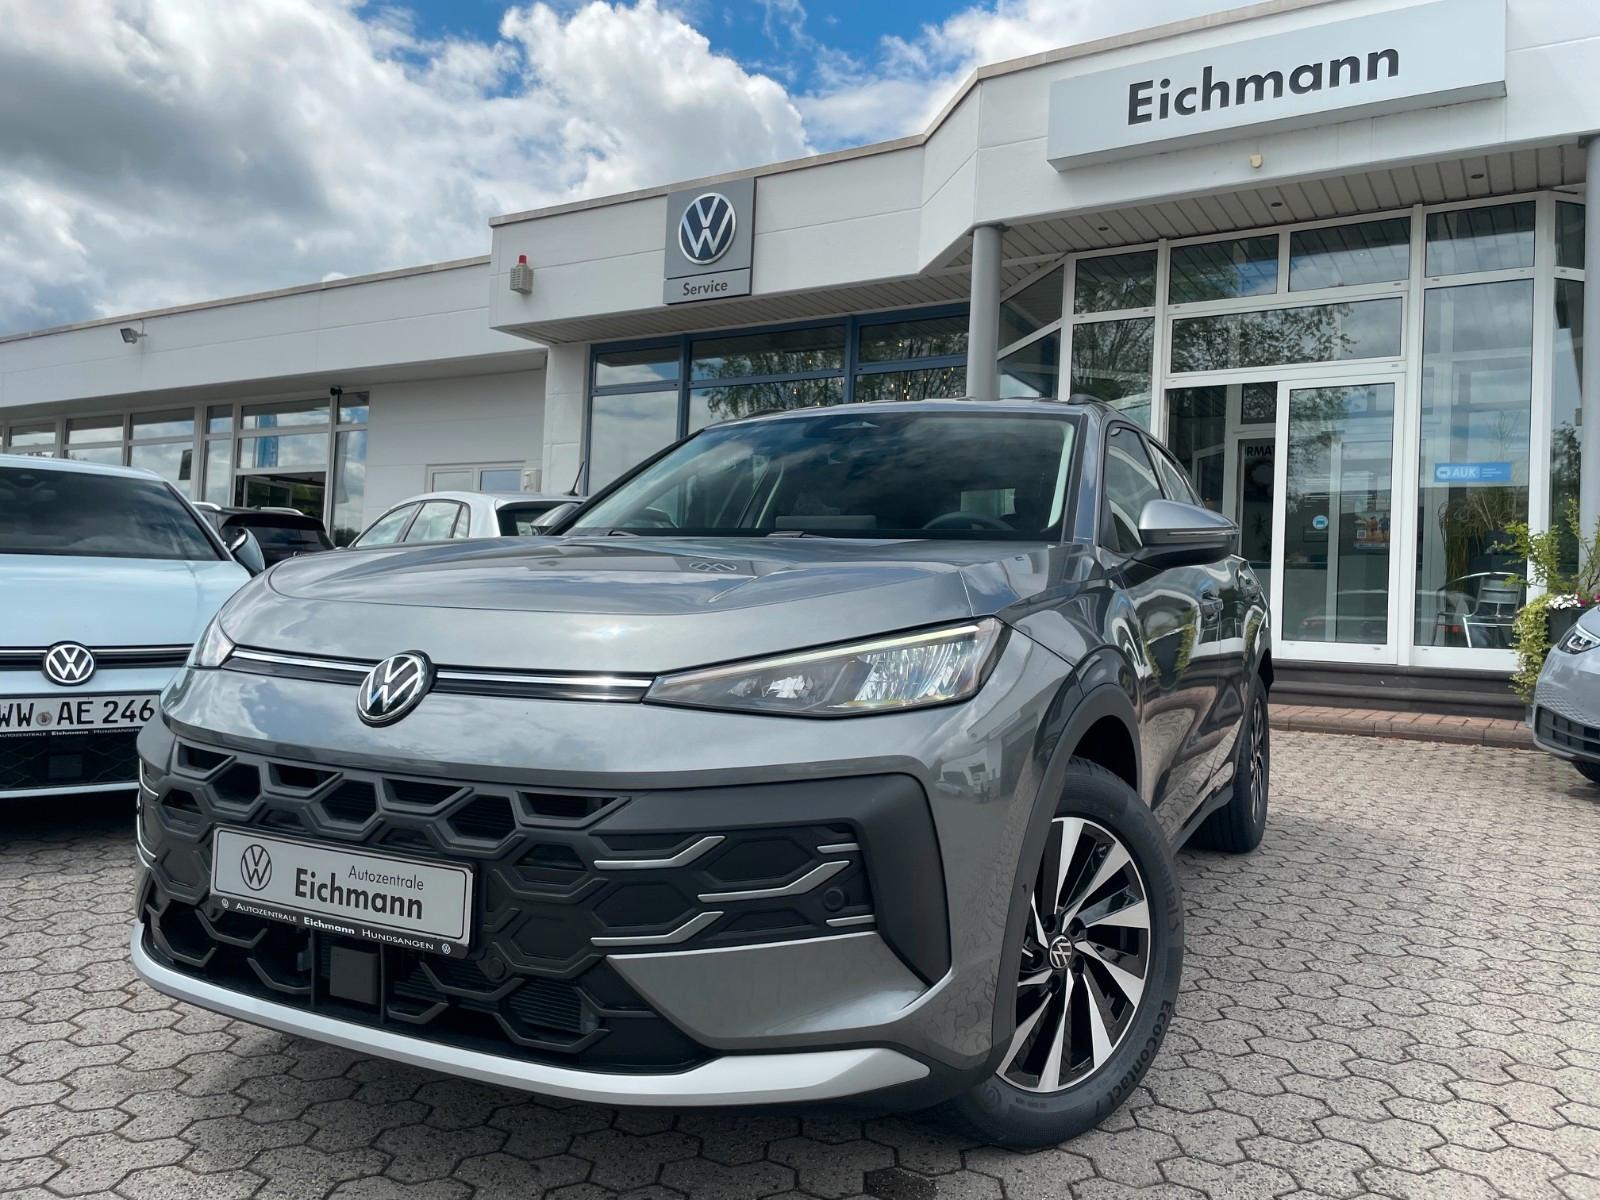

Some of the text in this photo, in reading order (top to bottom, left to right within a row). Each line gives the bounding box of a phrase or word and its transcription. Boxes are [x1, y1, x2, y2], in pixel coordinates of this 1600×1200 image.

[1128, 48, 1399, 125] Eichmann
[679, 193, 736, 264] VW
[683, 280, 728, 296] Service
[46, 644, 94, 683] VW
[358, 654, 425, 719] VW
[57, 701, 94, 725] AE
[102, 698, 156, 724] 246
[240, 844, 273, 891] VW
[348, 865, 424, 891] Autozentrale
[295, 867, 423, 919] Eichmann
[236, 902, 434, 951] AUTOZENTRALE Eichmann HUNDSANGEN
[1107, 1000, 1173, 1106] EcoContact
